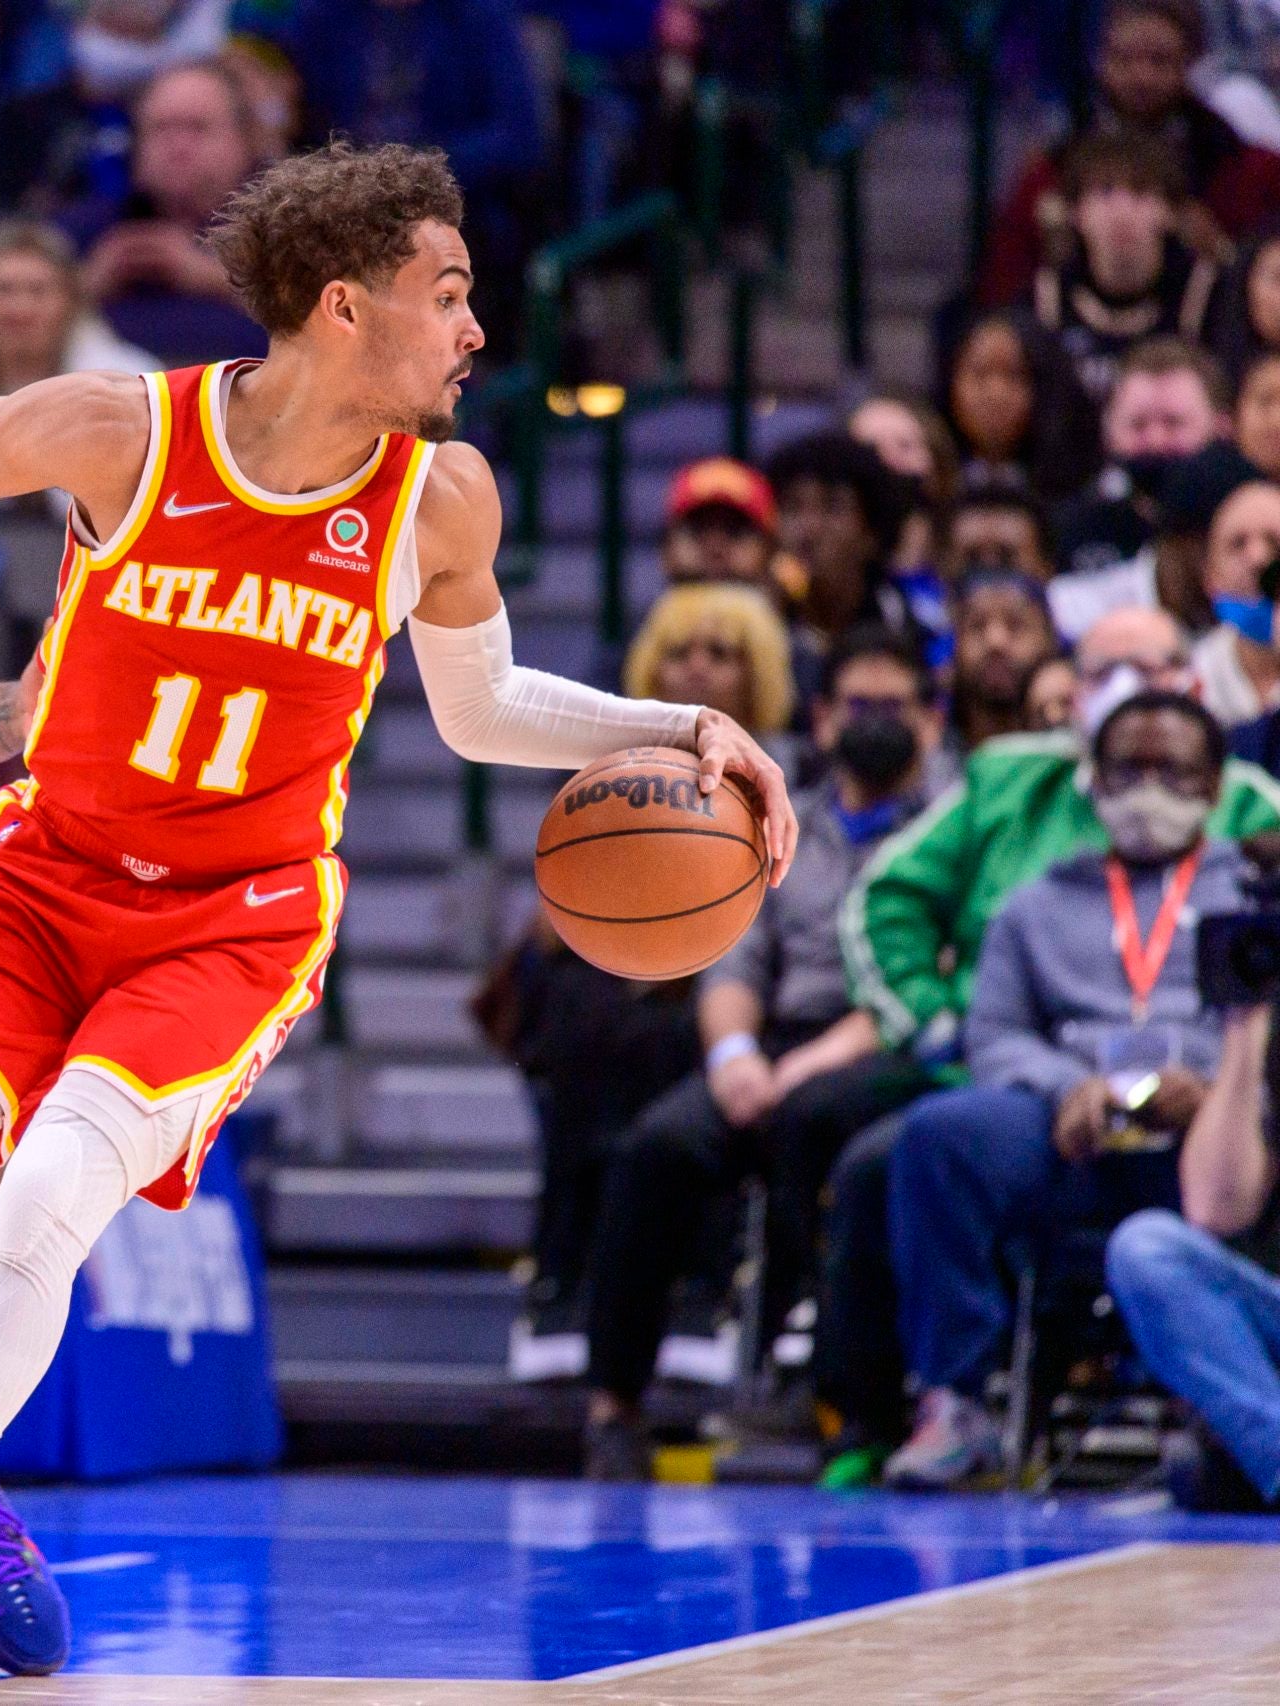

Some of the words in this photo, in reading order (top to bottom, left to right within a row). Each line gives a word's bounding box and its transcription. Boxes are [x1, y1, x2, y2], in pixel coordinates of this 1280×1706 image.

[308, 550, 371, 573] sharecare
[103, 560, 374, 670] ATLANTA
[128, 671, 268, 796] 11
[563, 774, 716, 819] Wilson
[121, 853, 171, 878] HAWKS
